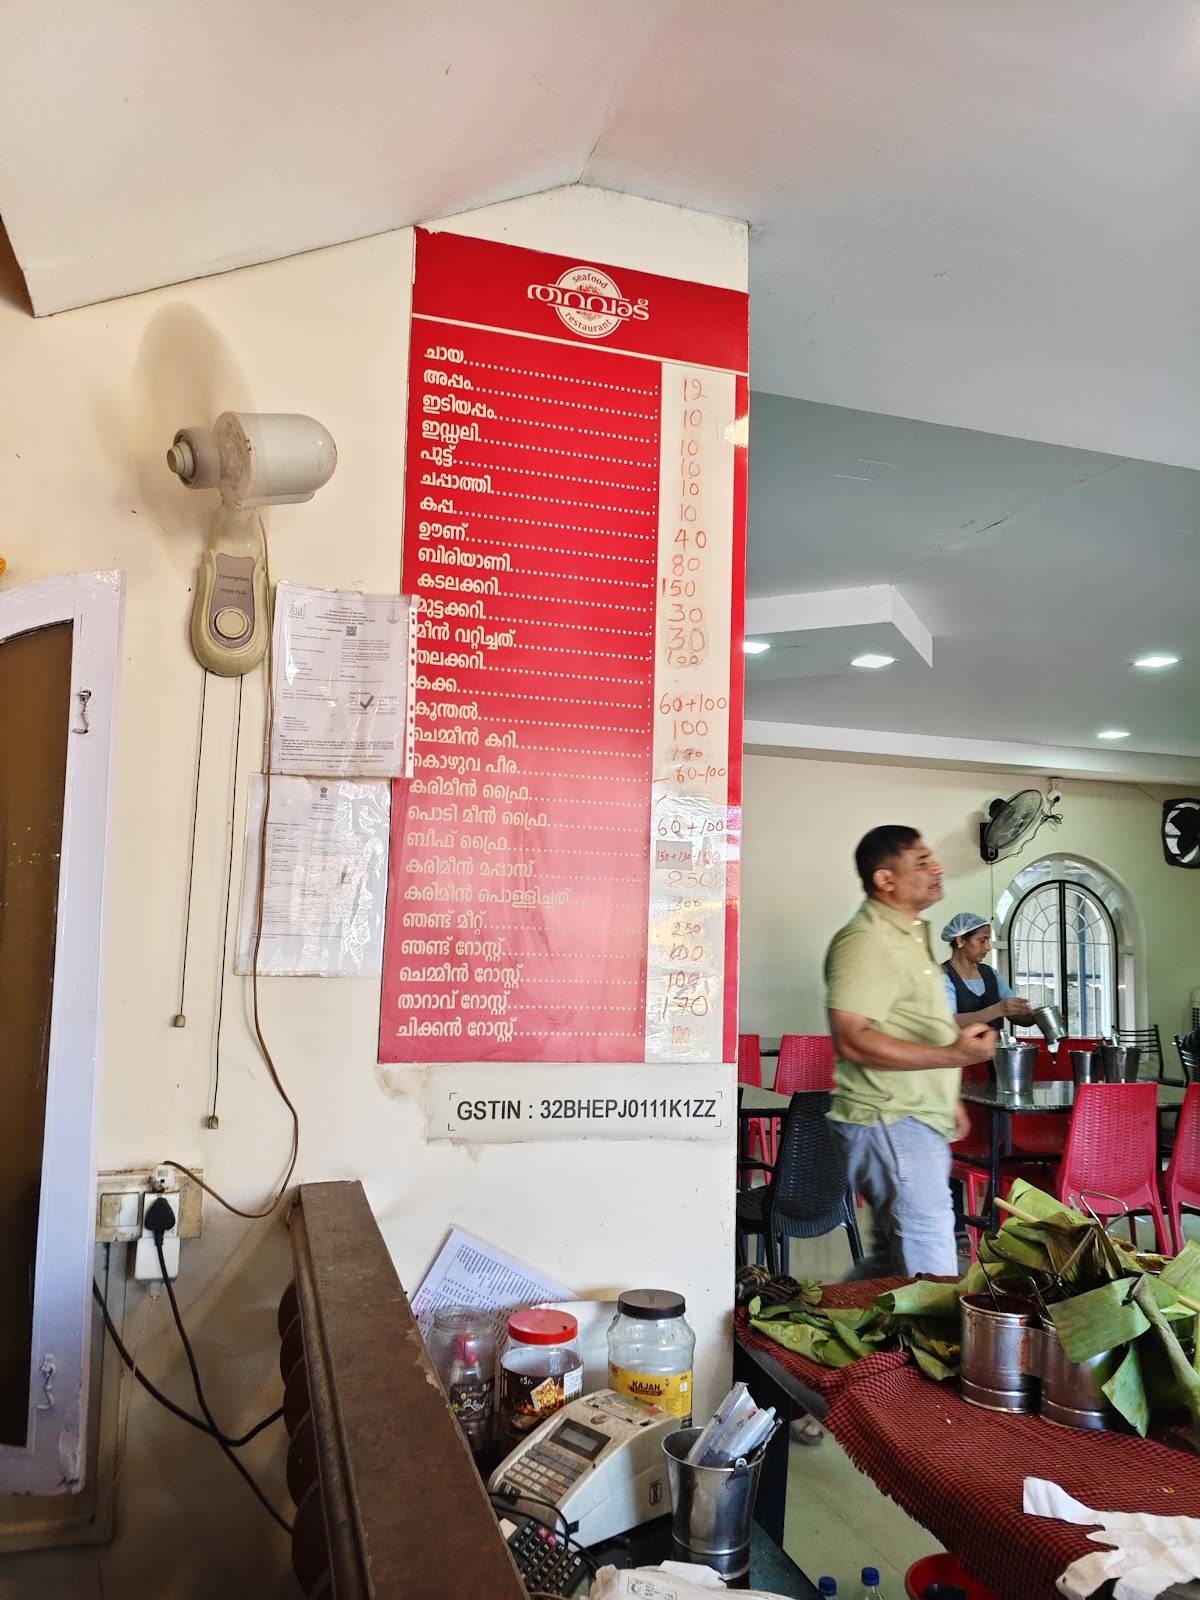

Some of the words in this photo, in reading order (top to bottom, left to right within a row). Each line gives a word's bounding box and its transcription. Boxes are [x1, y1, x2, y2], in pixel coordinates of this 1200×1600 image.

[572, 273, 608, 289] seafood
[565, 312, 614, 333] restaurant
[424, 346, 464, 363] ചായ
[423, 369, 472, 391] അപ്പം
[684, 378, 708, 402] 12
[423, 394, 496, 419] ഇടിയപ്പം
[683, 409, 702, 428] 10
[681, 440, 698, 456] 10
[682, 458, 700, 477] 10
[420, 472, 492, 494] ചപ്പാത്തി
[683, 480, 699, 496] 10
[419, 496, 454, 514] കപ്പ
[418, 521, 469, 541] ഊണ്
[674, 528, 707, 550] 40
[418, 545, 511, 572] ബിരിയാണി
[672, 554, 701, 576] 80
[417, 573, 499, 596] കടലക്കറി
[662, 578, 696, 597] 150
[669, 604, 703, 623] 30
[668, 627, 705, 652] 30
[415, 649, 485, 670] തലക്കറി
[668, 651, 699, 665] 100
[415, 675, 457, 693] കക്ക
[485, 730, 517, 749] കറി
[674, 720, 708, 740] 100
[485, 755, 517, 774] പീര
[409, 776, 477, 797] കരിമീൻ
[408, 804, 458, 822] പൊടി
[463, 805, 496, 824] മീൻ
[405, 855, 473, 876] കരിമീൻ
[404, 882, 472, 901] കരിമീൻ
[400, 962, 469, 983] ചെമ്മീൻ
[398, 990, 459, 1010] താറാവ്
[396, 1017, 462, 1037] ചിക്കൻ
[457, 1100, 521, 1121] GSTIN
[540, 1099, 716, 1119] 32BHEPJ0111K1ZZ
[632, 1380, 661, 1392] KAJAH
